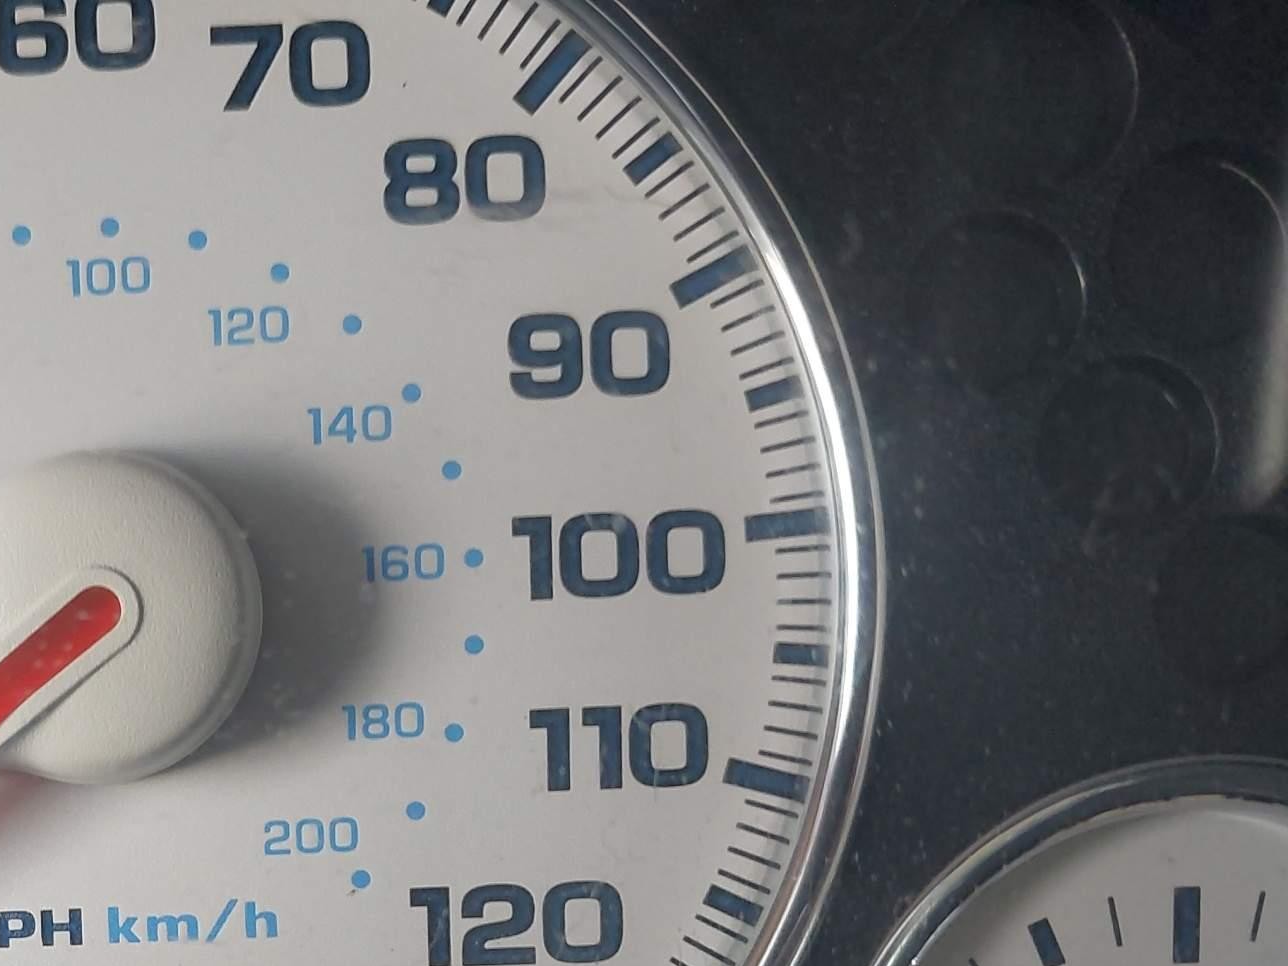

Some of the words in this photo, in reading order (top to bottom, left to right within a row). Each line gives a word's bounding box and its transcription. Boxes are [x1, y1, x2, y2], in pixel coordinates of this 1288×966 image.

[210, 20, 371, 112] 70
[383, 135, 546, 225] 80
[66, 257, 151, 297] 100
[208, 306, 290, 347] 120
[508, 310, 671, 400] 90
[307, 405, 392, 446] 140
[364, 544, 445, 582] 160
[512, 509, 726, 601] 100
[342, 702, 425, 742] 180
[530, 703, 709, 792] 110
[263, 817, 358, 856] 200
[107, 898, 279, 943] km/h
